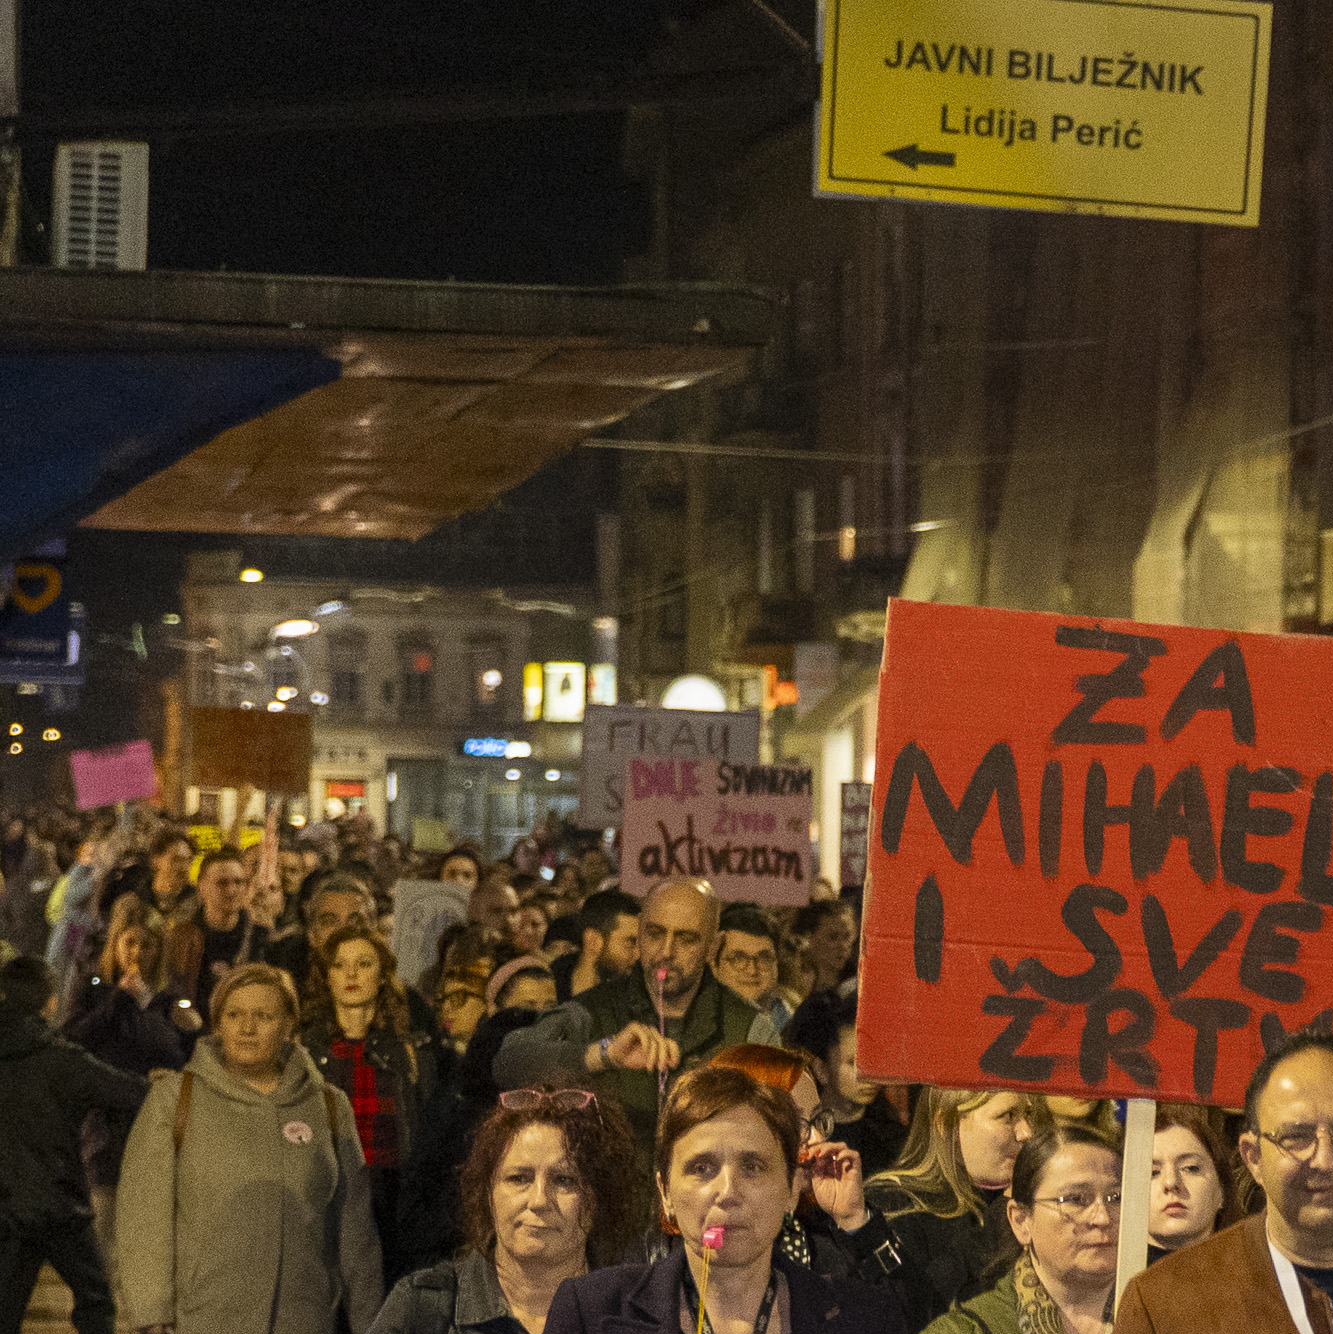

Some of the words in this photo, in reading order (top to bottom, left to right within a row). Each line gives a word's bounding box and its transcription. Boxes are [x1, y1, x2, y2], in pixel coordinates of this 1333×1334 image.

[884, 40, 994, 77] JAVNI
[1007, 49, 1206, 96] BILJEŽNIK
[940, 105, 1038, 147] Lidija
[1050, 114, 1144, 151] Perić
[1051, 624, 1257, 746] ZA
[913, 872, 945, 984] I
[1027, 883, 1326, 1004] SVE
